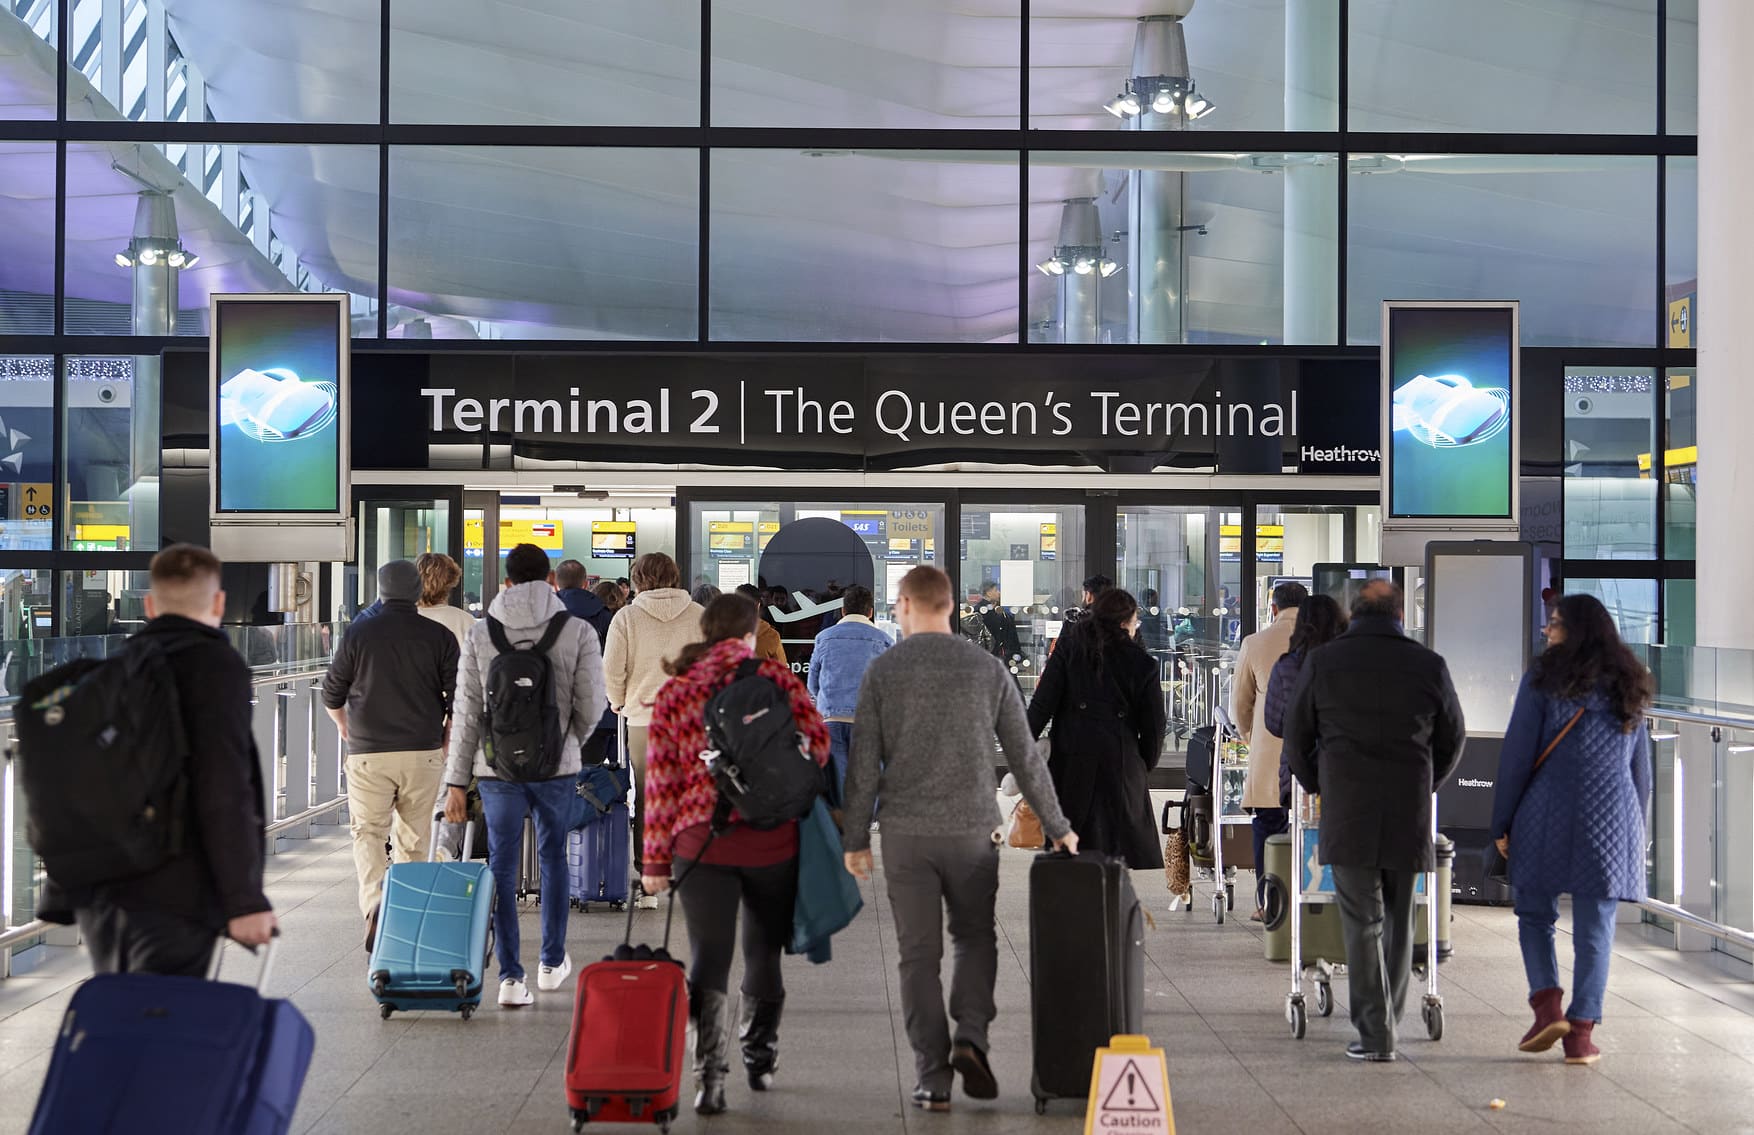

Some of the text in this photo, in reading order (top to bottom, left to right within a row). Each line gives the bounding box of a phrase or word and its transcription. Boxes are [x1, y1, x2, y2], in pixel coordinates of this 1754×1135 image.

[421, 387, 1297, 442] Terminal 2 The Queen’s Terminal
[1301, 445, 1381, 462] Heathrow
[852, 523, 870, 531] SAS
[892, 522, 928, 532] Toilets
[1457, 778, 1494, 788] Heathrow
[1100, 1113, 1161, 1127] Caution
